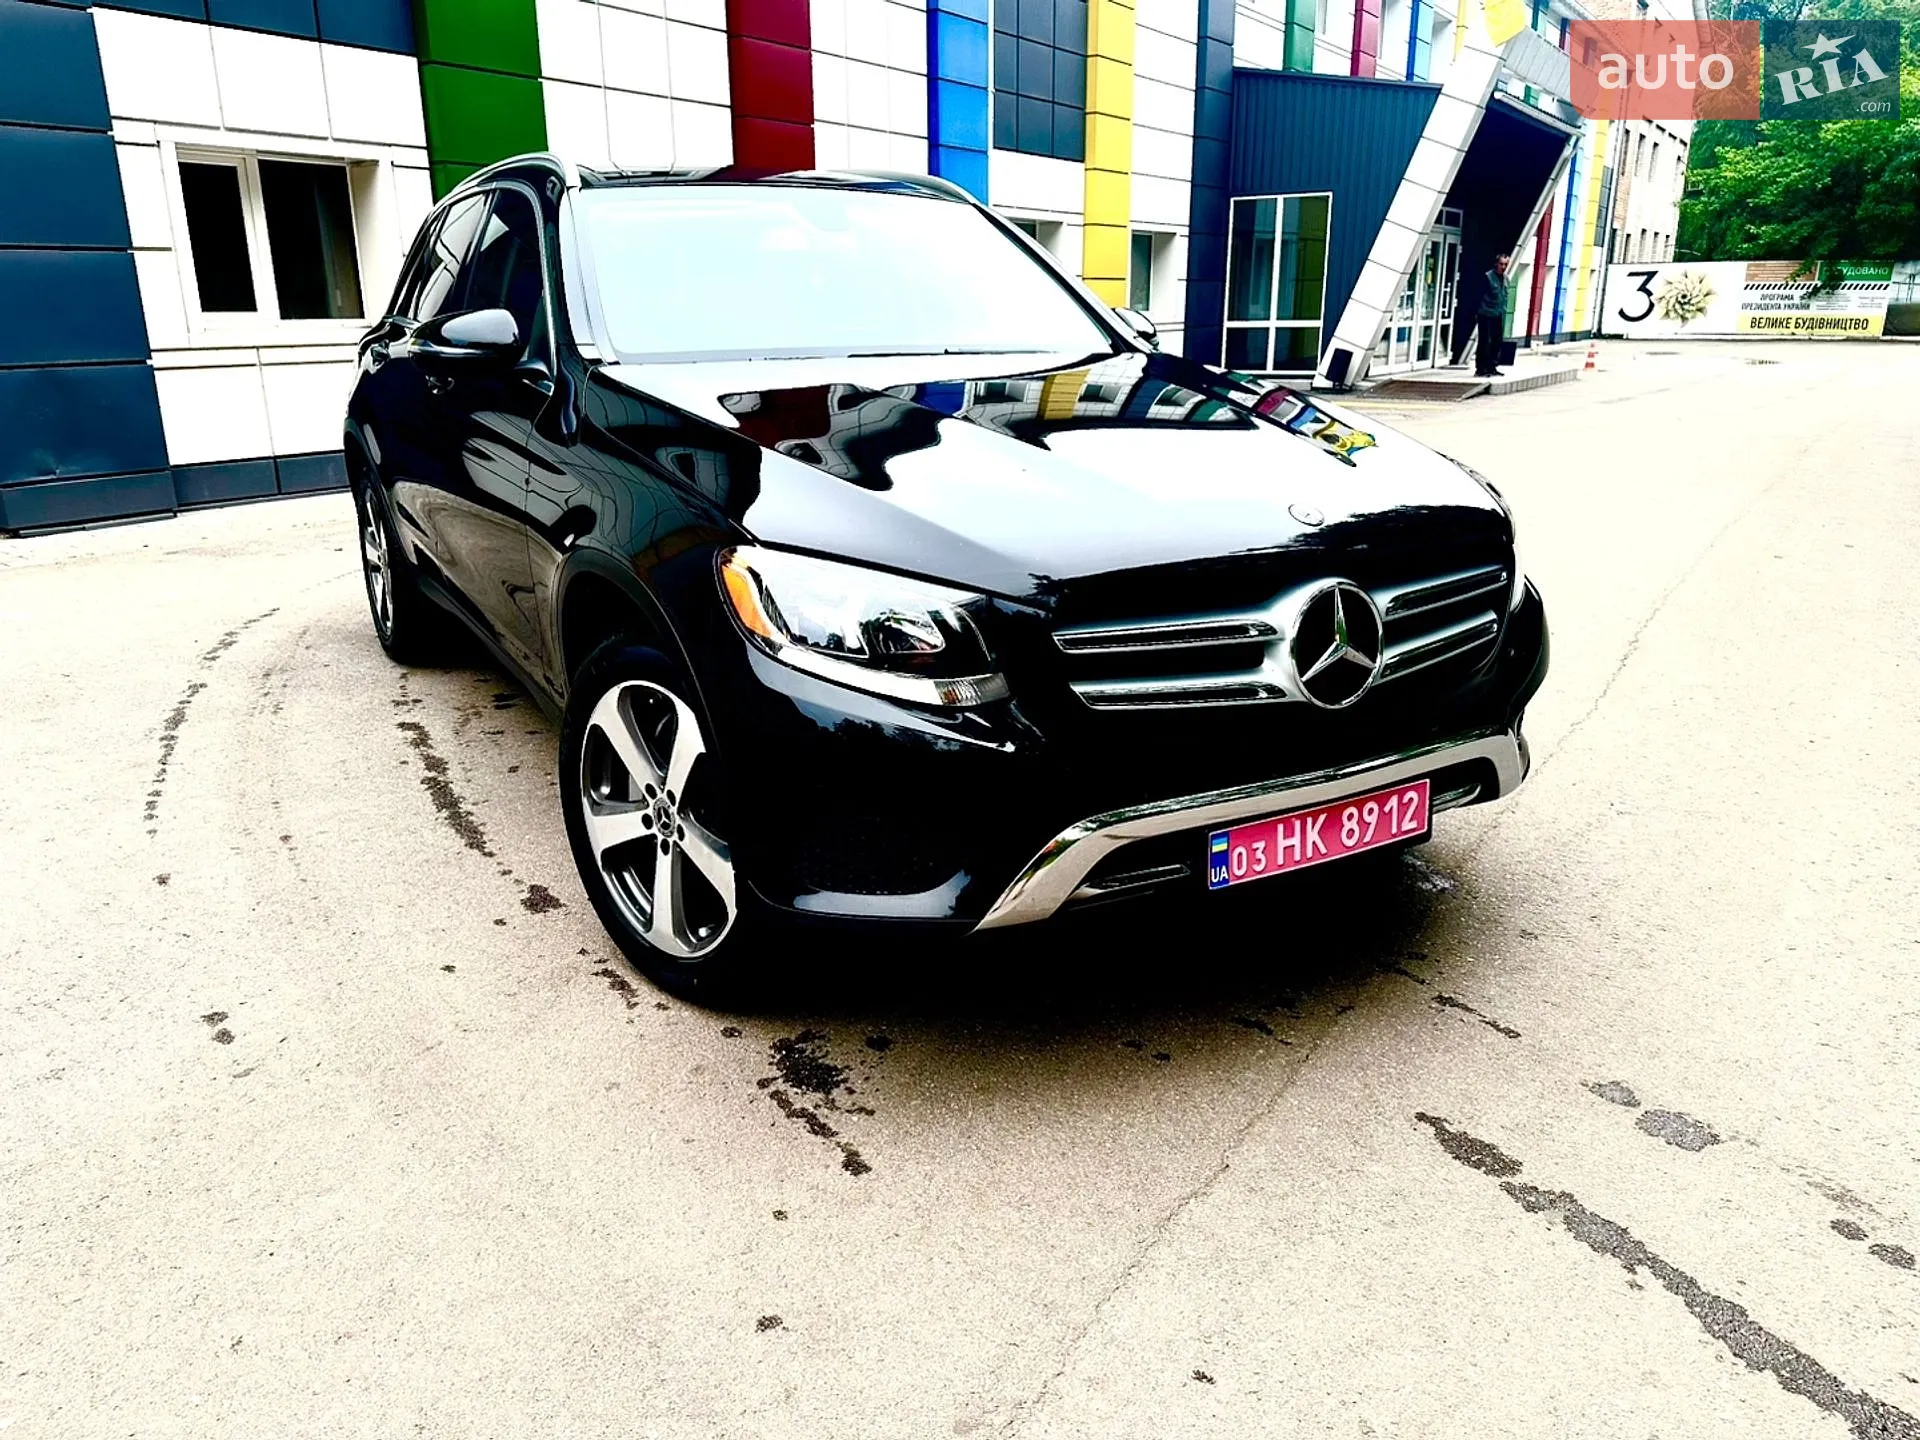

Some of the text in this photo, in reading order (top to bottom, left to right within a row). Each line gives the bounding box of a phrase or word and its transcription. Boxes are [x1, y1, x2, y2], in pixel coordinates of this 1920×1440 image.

[1750, 317, 1869, 331] ВЕЛИКЕ БУДІВНИЦТВО
[1231, 790, 1420, 877] 03 HK 8912
[1211, 865, 1229, 882] UA
